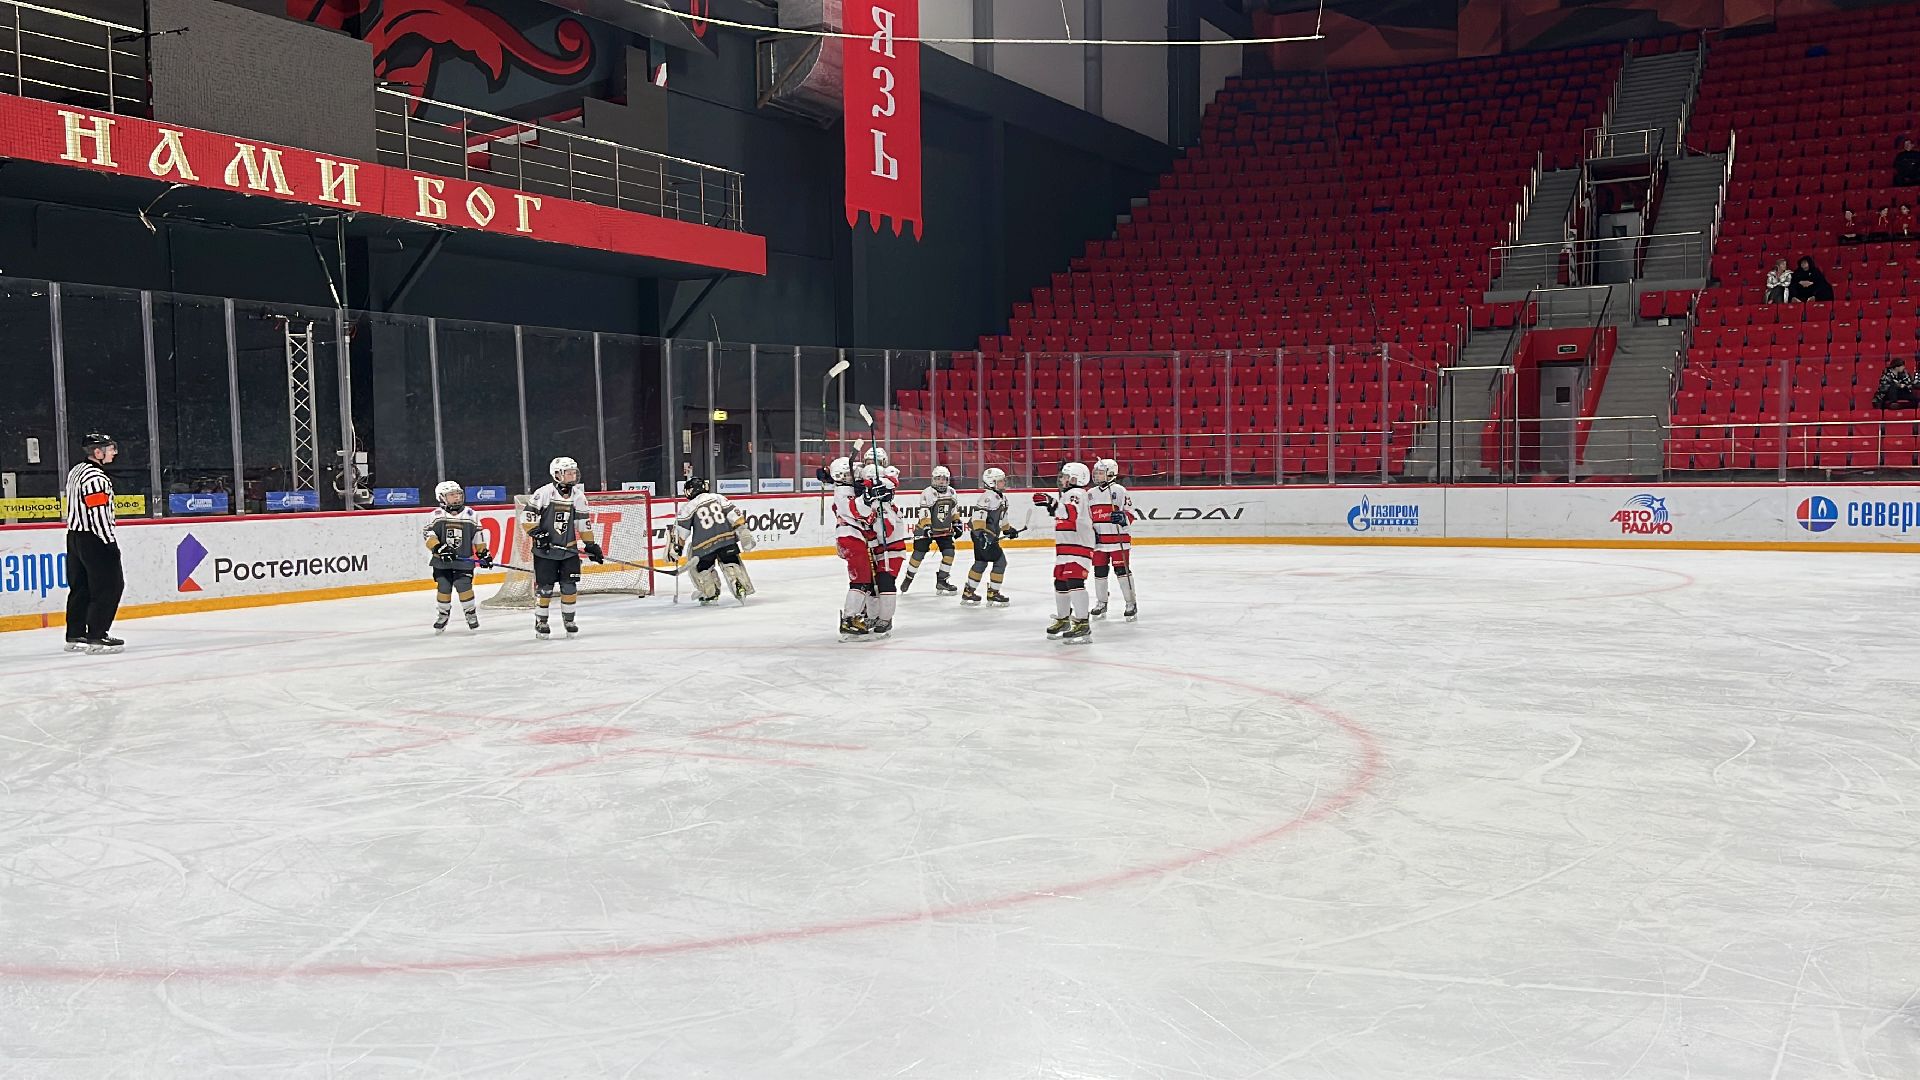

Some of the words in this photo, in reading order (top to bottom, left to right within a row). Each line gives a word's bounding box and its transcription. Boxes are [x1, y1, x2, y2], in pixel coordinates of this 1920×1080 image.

[57, 109, 363, 208] НАМИ
[413, 175, 543, 234] БОГ
[696, 502, 726, 530] 88
[1371, 505, 1419, 518] ГАЗПРОМ
[1609, 510, 1652, 523] АВТО
[1621, 522, 1674, 535] РАДИО
[214, 554, 368, 583] Ростелеком
